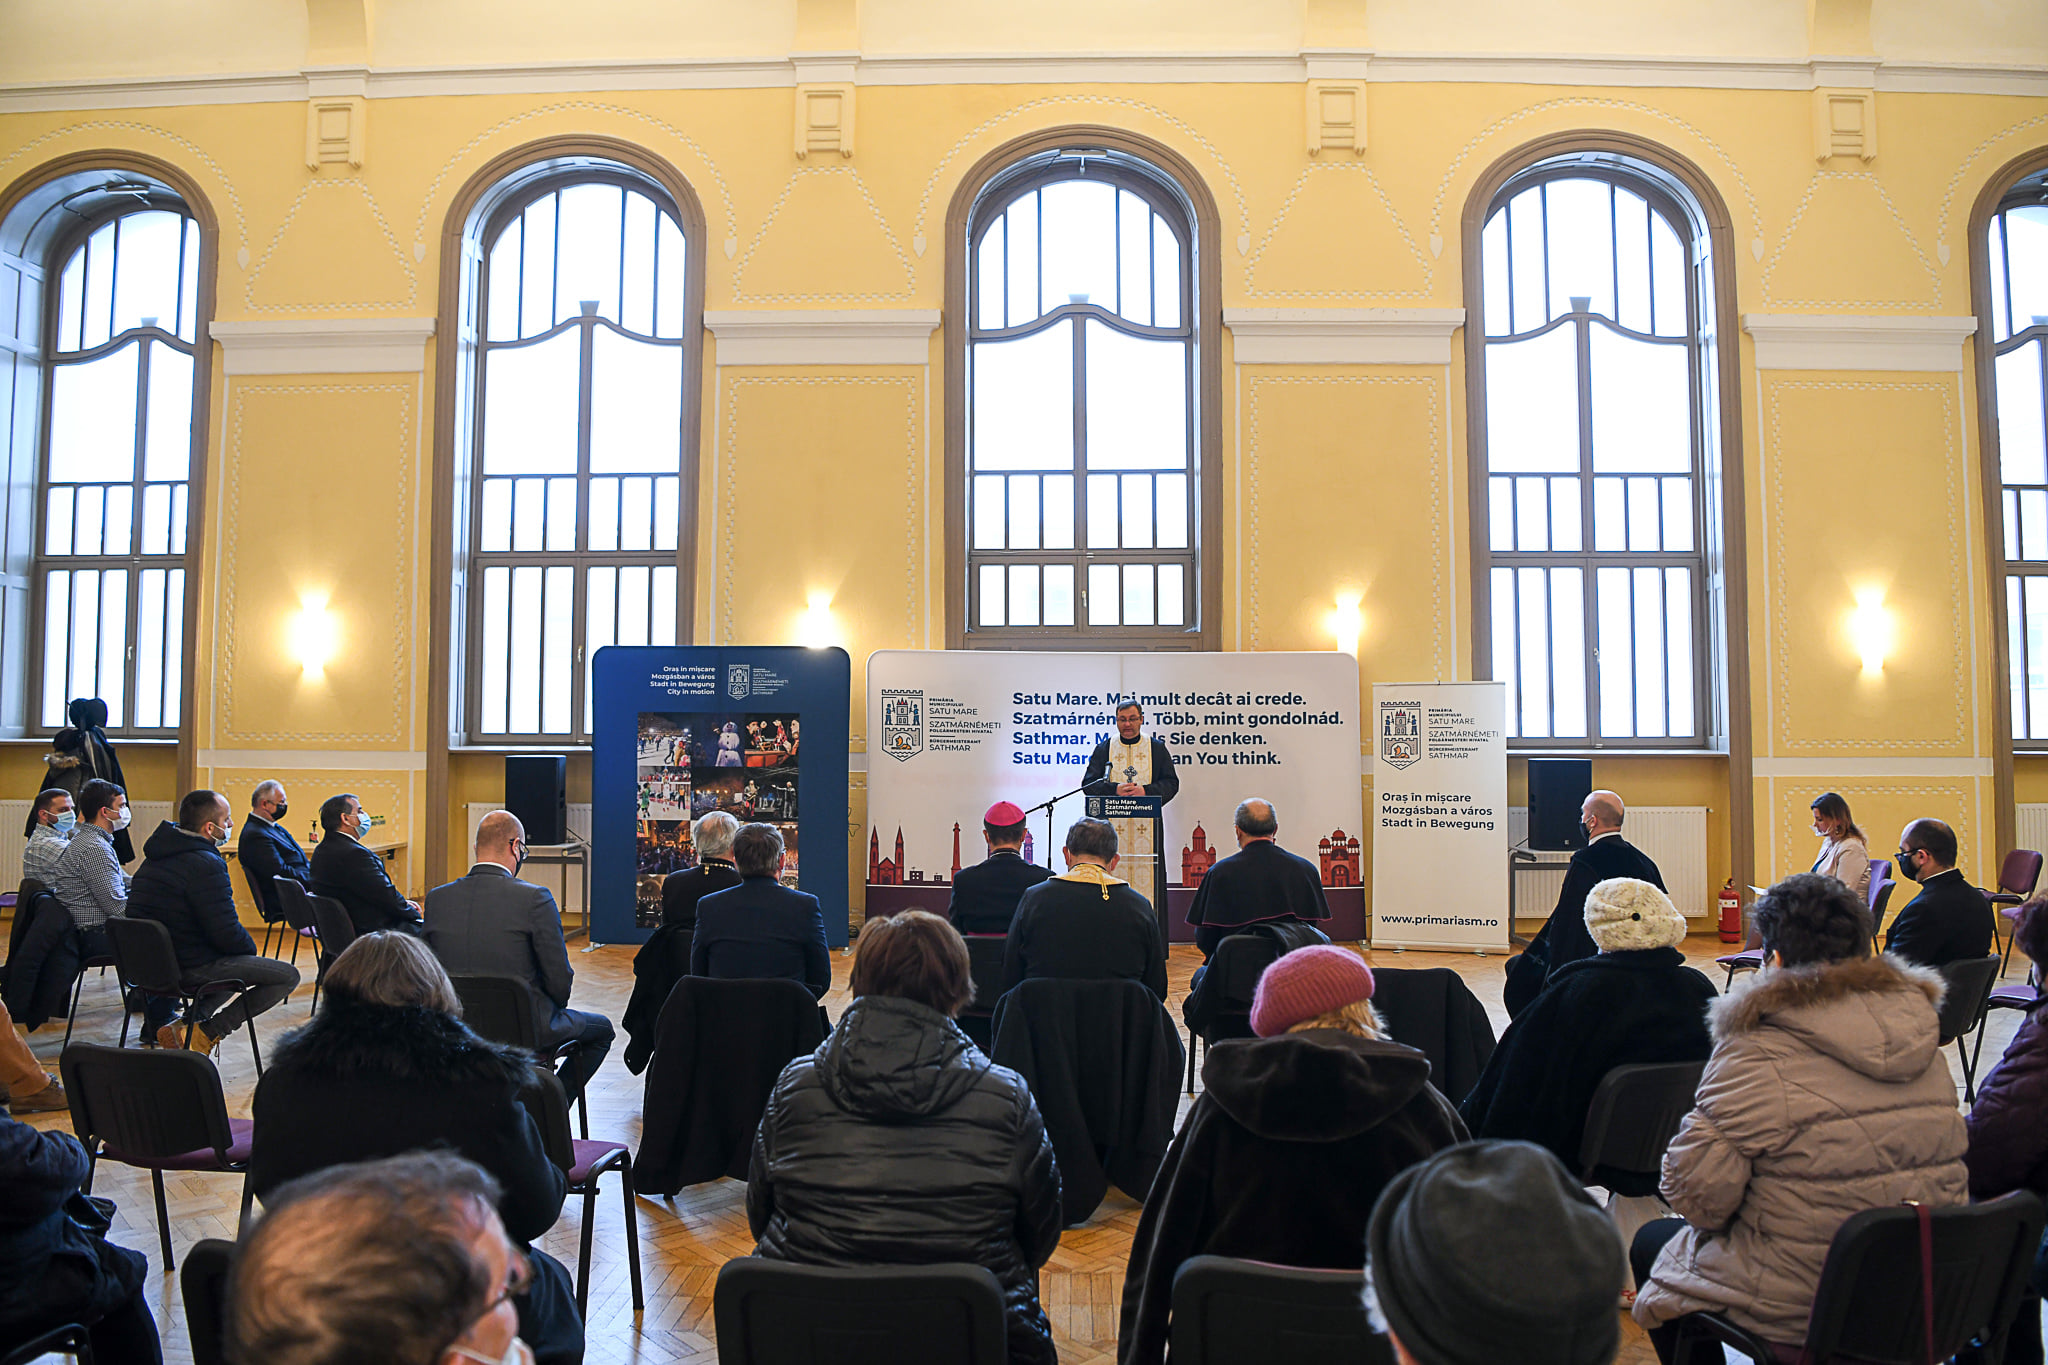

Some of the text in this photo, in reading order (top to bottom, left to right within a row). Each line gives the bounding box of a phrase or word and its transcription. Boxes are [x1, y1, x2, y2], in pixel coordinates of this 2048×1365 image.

[1012, 692, 1051, 705] Satu
[1056, 693, 1102, 705] Mare.
[1141, 692, 1181, 705] mult
[1185, 692, 1232, 705] decât
[1236, 691, 1250, 705] ai
[1255, 692, 1306, 705] crede.
[929, 720, 1001, 728] SZATMÁRNÉMETI
[1012, 711, 1344, 728] Szatmárnémi. Több, mint gondolnád.
[1012, 732, 1091, 745] Sathmar.
[1170, 731, 1195, 745] Sie
[1199, 731, 1267, 745] denken.
[1012, 752, 1051, 765] Satu
[1056, 752, 1092, 765] Mar
[1196, 752, 1228, 765] You
[1232, 751, 1281, 765] think.
[1382, 792, 1472, 804] Oraș în mișcare
[1382, 805, 1447, 816] Mozgásban
[1461, 806, 1493, 815] város
[1382, 818, 1494, 831] Stadt in Bewegung
[1381, 914, 1498, 926] www.primariasm.ro
